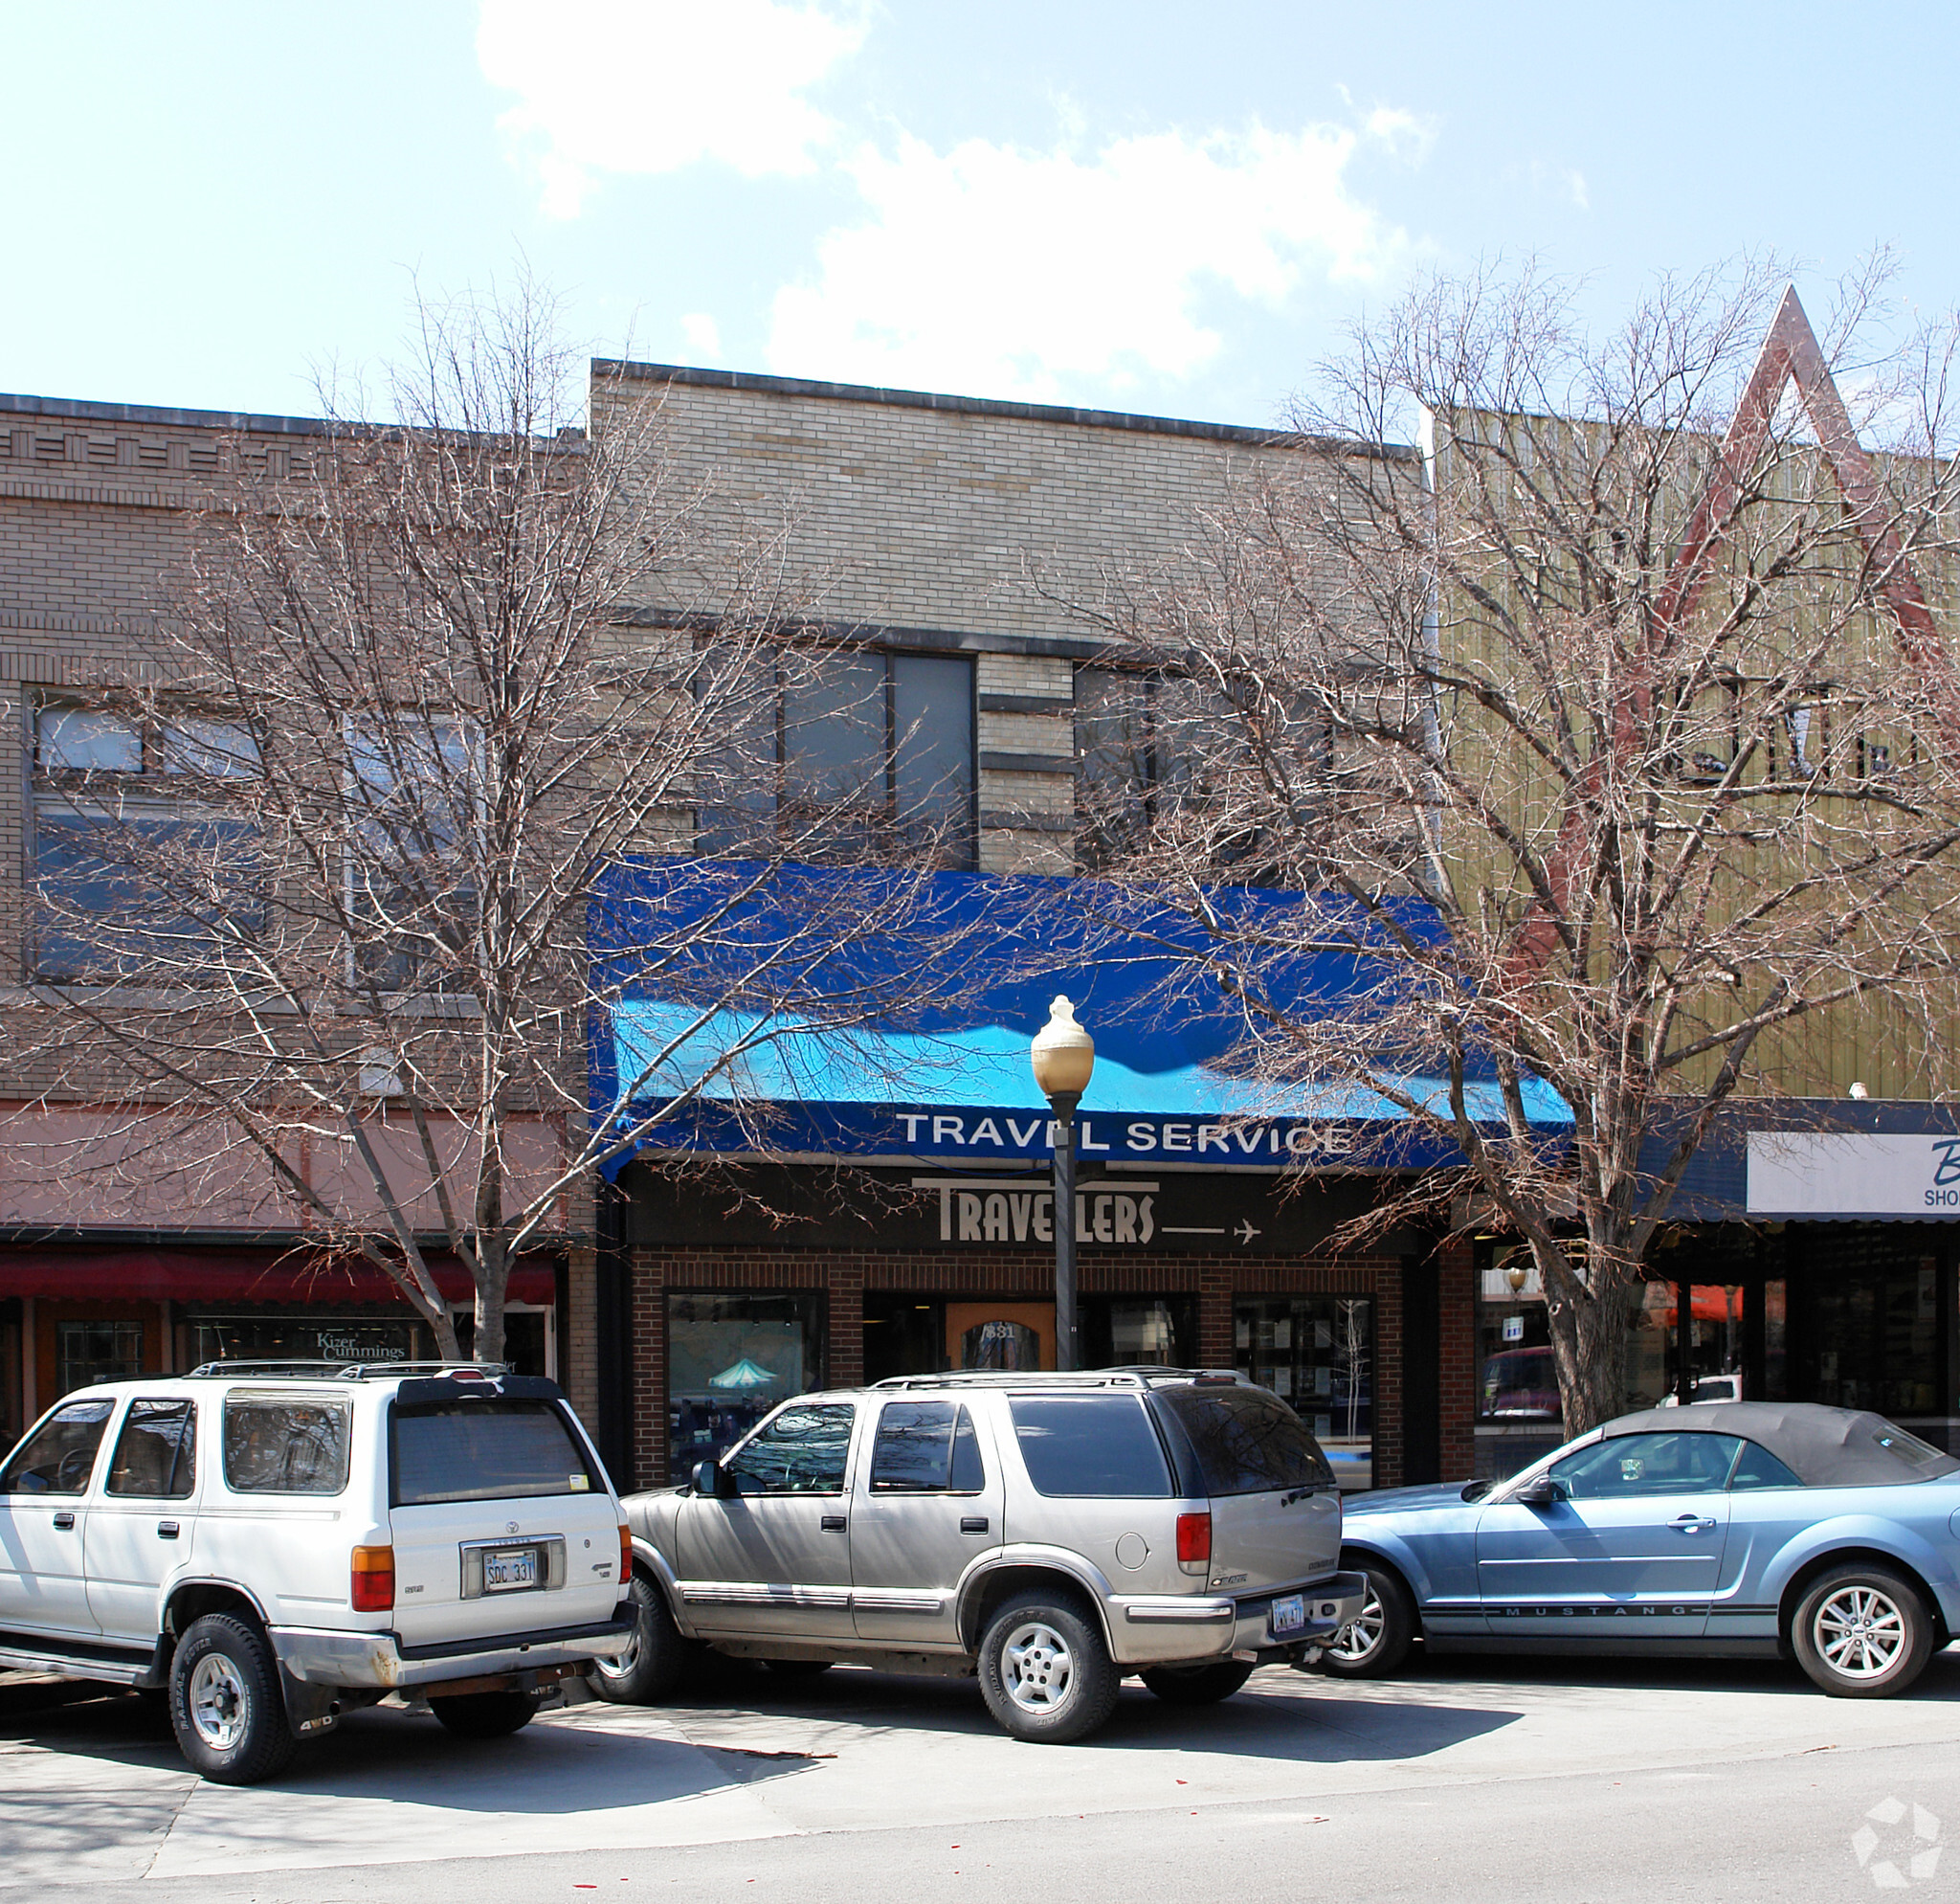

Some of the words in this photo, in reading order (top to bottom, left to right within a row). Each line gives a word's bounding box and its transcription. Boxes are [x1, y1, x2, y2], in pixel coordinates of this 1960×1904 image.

[1126, 1123, 1353, 1154] SERVICE
[1925, 1190, 1960, 1205] SHO
[911, 1177, 1159, 1244] TRAVELERS
[317, 1333, 356, 1348] Kizer
[323, 1345, 405, 1362] Cummings
[488, 1565, 507, 1584] SDC
[514, 1562, 532, 1581] 331
[1506, 1606, 1685, 1616] MUSTANG
[184, 1637, 212, 1666] ROVER
[300, 1715, 332, 1731] 4WD
